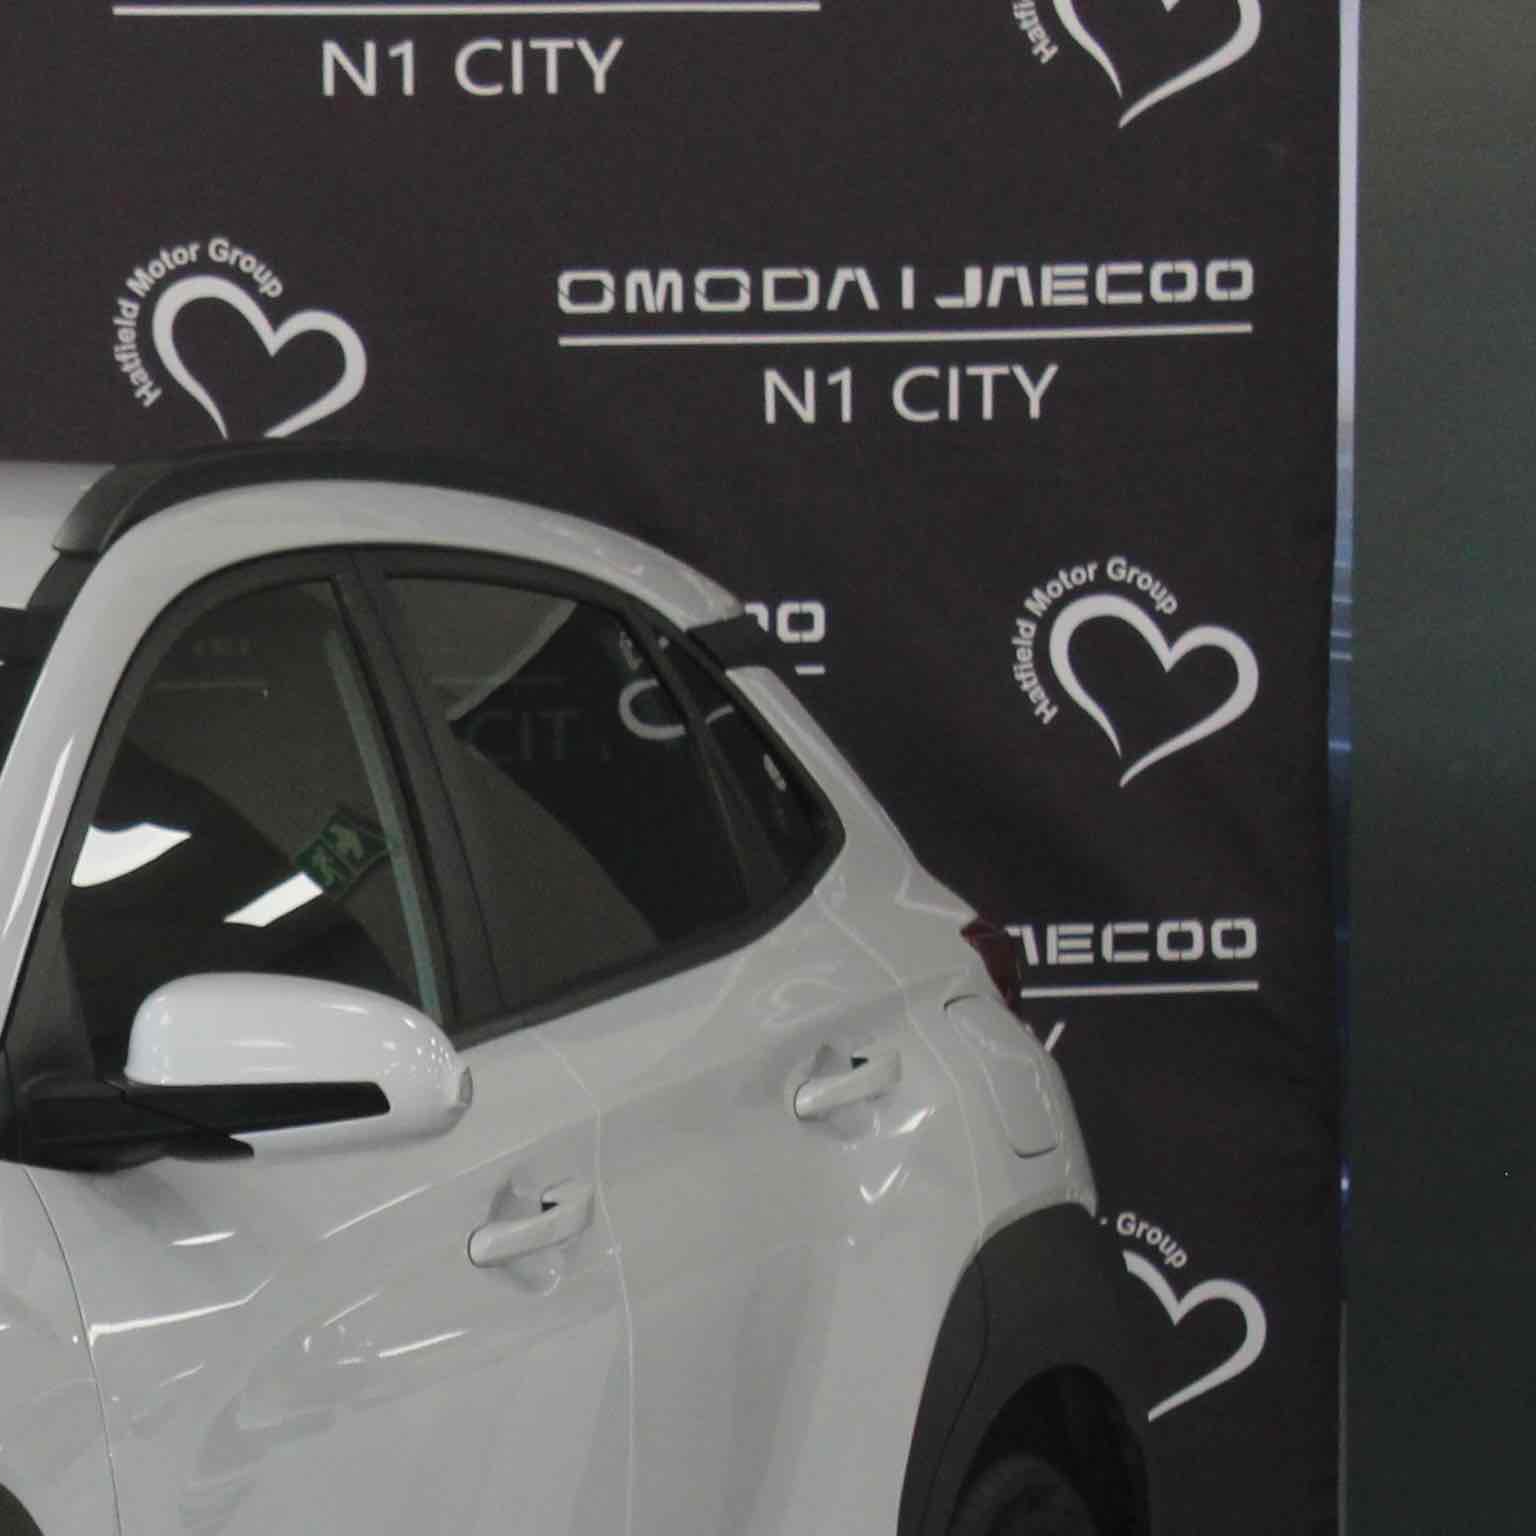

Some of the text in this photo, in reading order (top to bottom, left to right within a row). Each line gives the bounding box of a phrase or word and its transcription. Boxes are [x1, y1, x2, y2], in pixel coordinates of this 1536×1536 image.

[1011, 0, 1059, 65] Hatfi
[322, 38, 623, 97] N1 CITY
[557, 267, 879, 314] OMODA
[935, 259, 1254, 309] JAECOO
[112, 236, 283, 408] Hatfield Motor Group
[764, 364, 1059, 424] N1 CITY
[1011, 555, 1178, 725] Hatfield Motor Group
[1004, 917, 1258, 966] AECOO
[1116, 1211, 1187, 1269] Group
